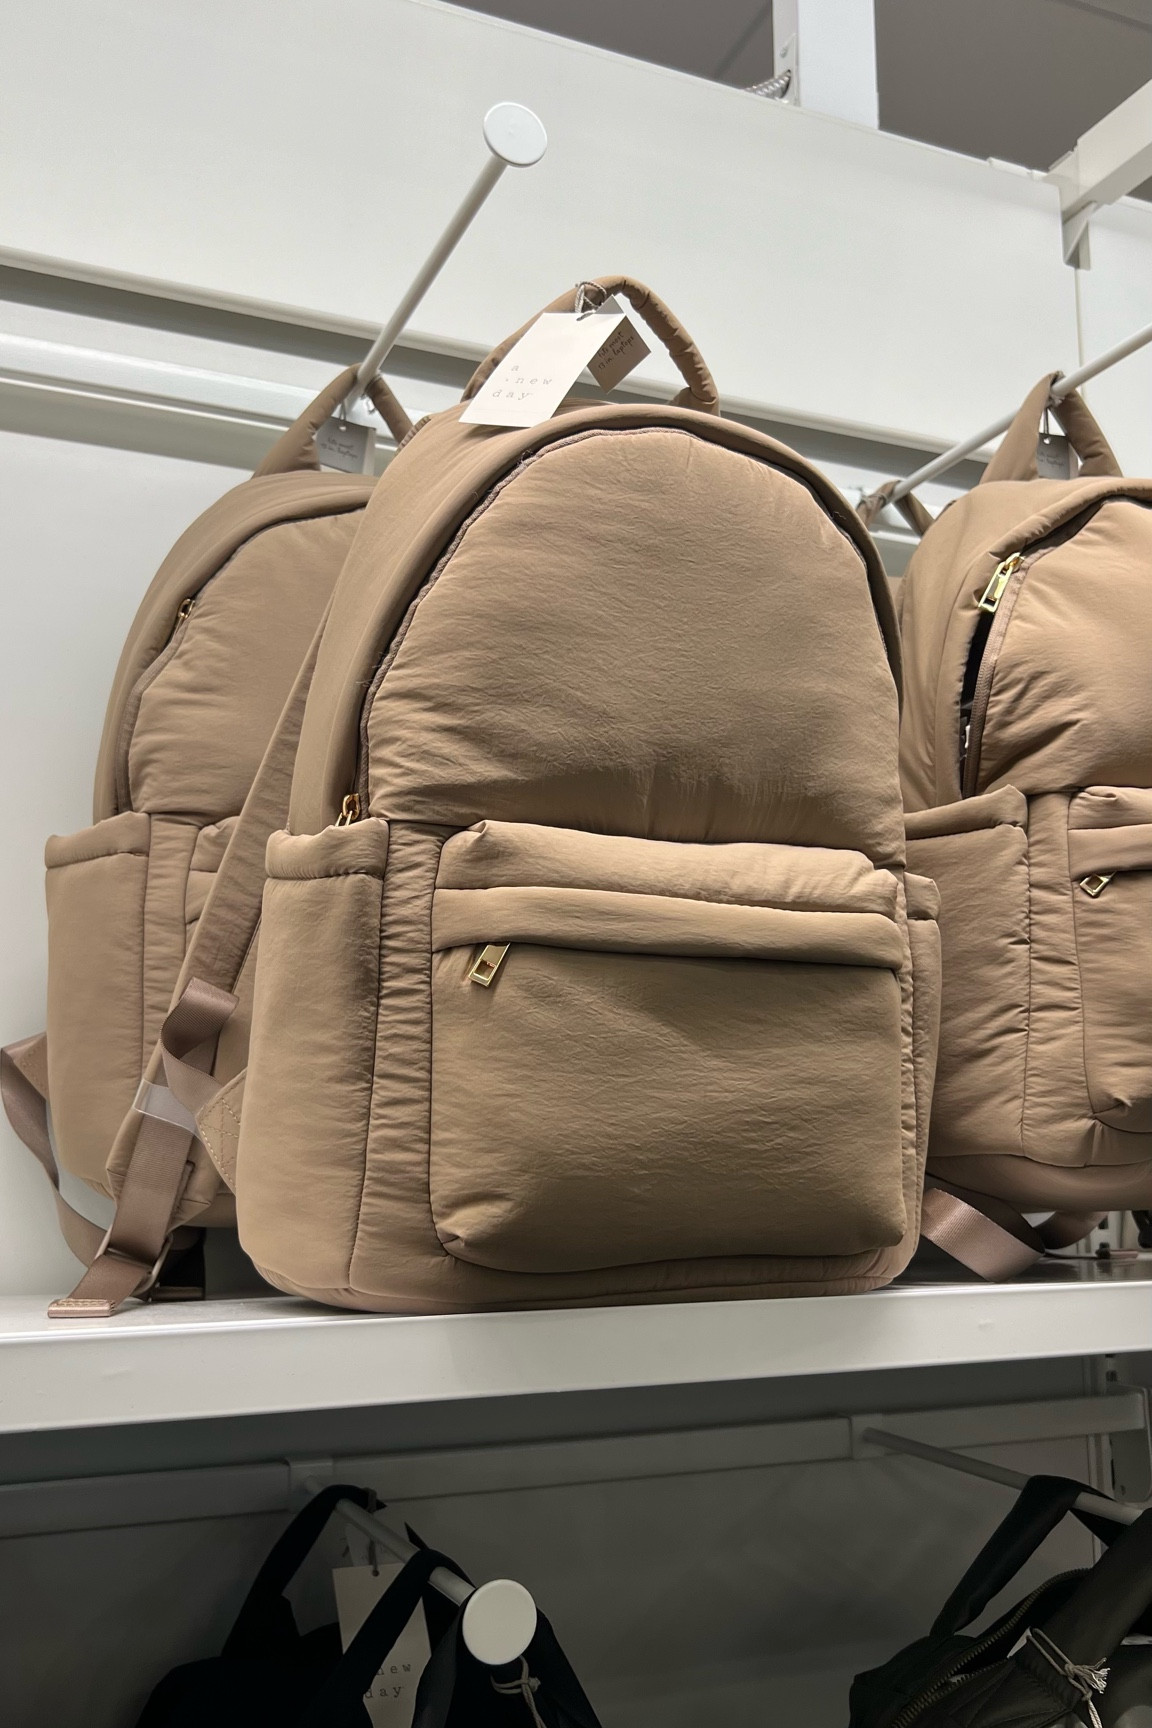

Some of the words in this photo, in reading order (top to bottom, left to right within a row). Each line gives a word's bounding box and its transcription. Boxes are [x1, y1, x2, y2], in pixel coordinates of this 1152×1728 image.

[515, 377, 553, 385] new
[492, 389, 530, 401] day
[364, 1686, 401, 1698] day
